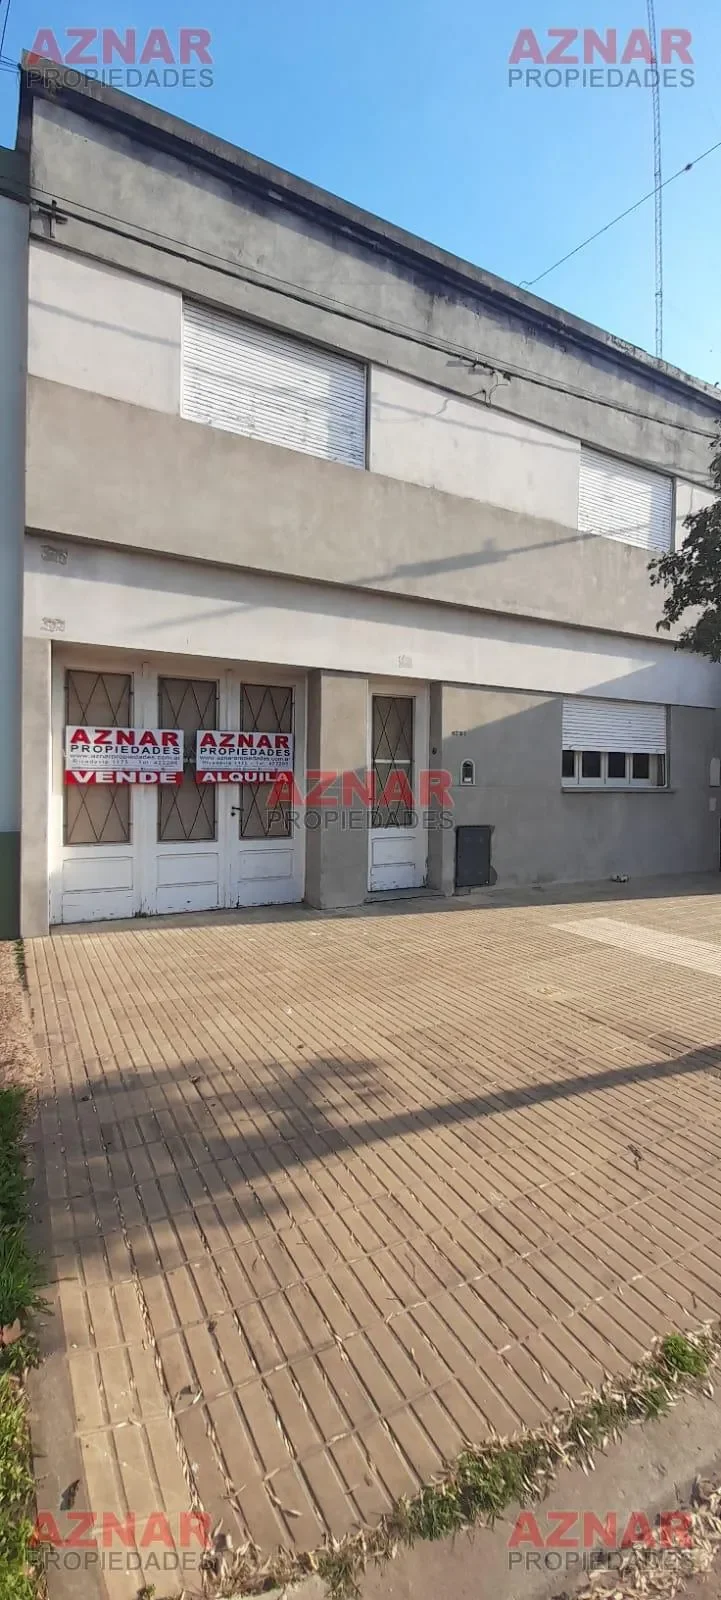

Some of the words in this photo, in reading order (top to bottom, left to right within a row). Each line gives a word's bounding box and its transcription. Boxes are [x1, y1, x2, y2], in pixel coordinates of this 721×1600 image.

[70, 728, 179, 746] AZNAR
[200, 732, 289, 748] AZNAR
[70, 745, 180, 754] PROPIEDADES
[200, 747, 290, 757] PROPIEDADES
[71, 771, 177, 783] VENDE
[202, 772, 289, 782] ALQUILA
